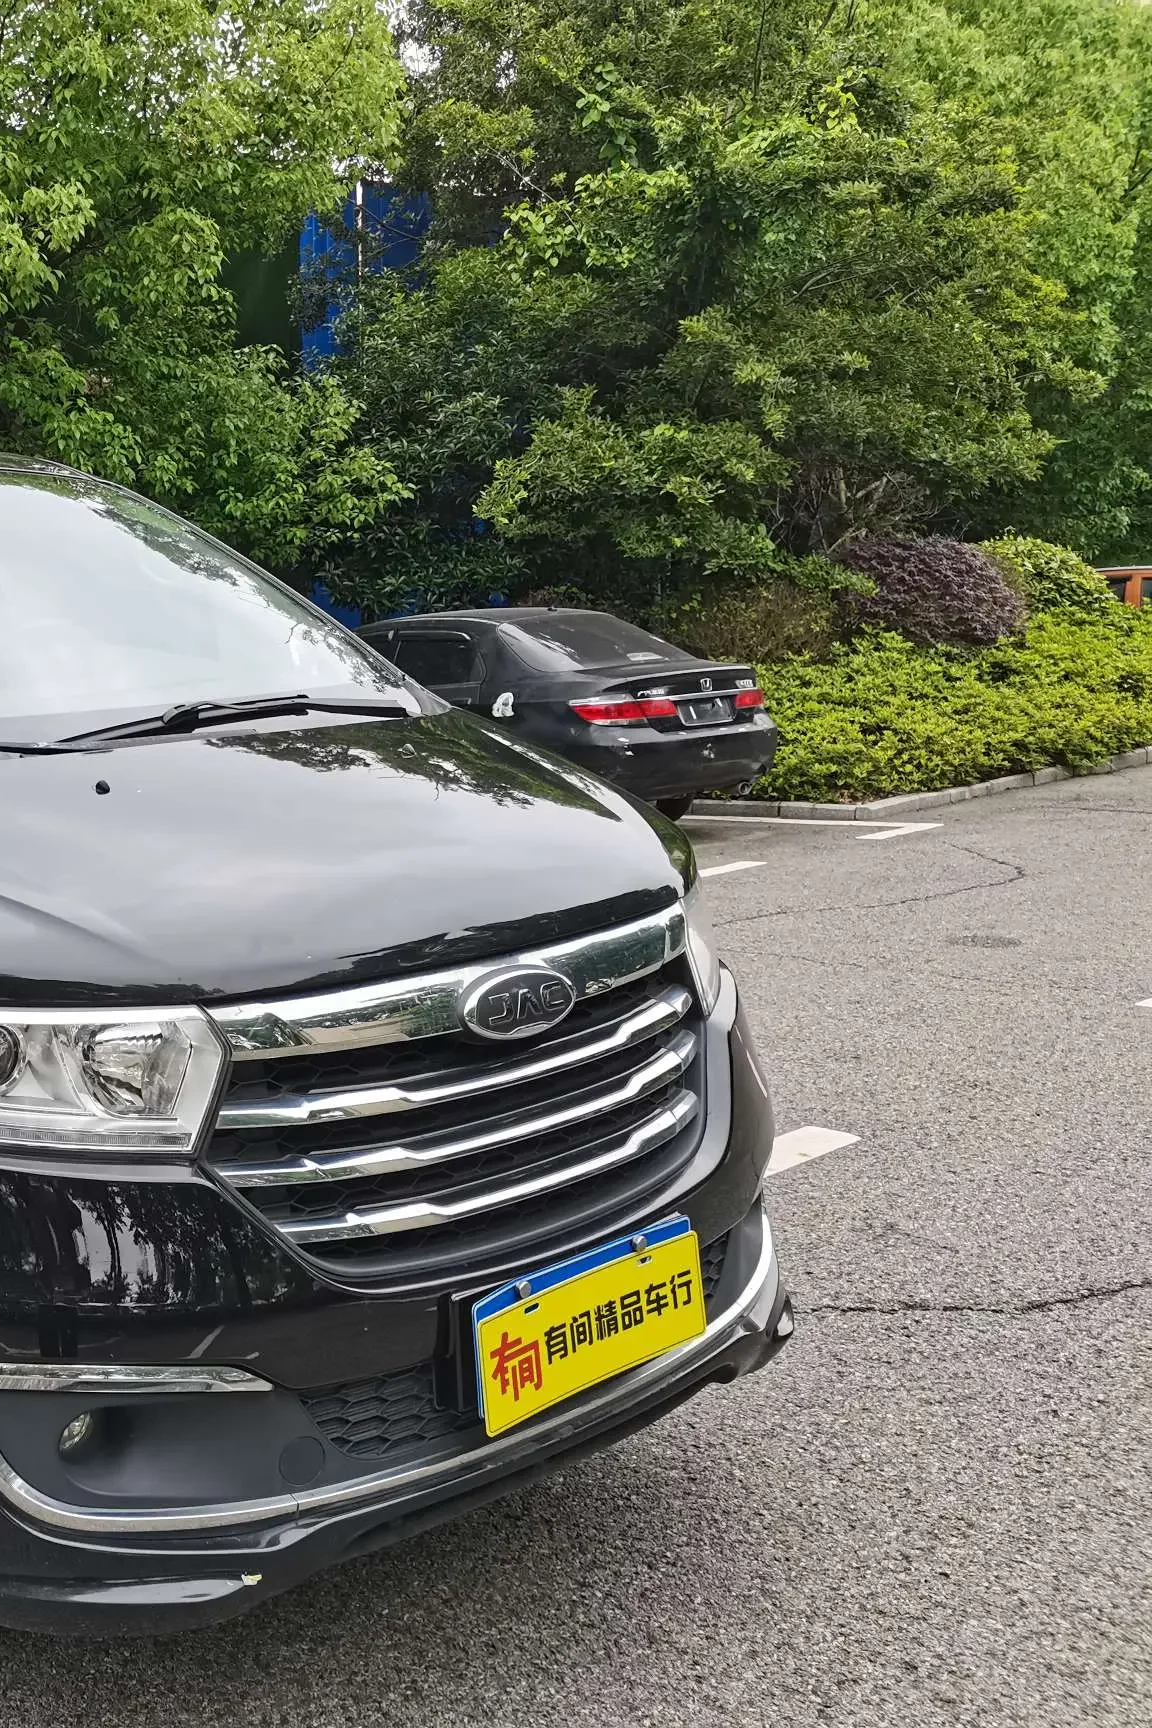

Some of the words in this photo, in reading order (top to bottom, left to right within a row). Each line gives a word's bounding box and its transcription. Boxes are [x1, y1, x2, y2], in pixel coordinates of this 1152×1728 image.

[488, 980, 566, 1026] JAC
[544, 1269, 693, 1365] 有间精品车行
